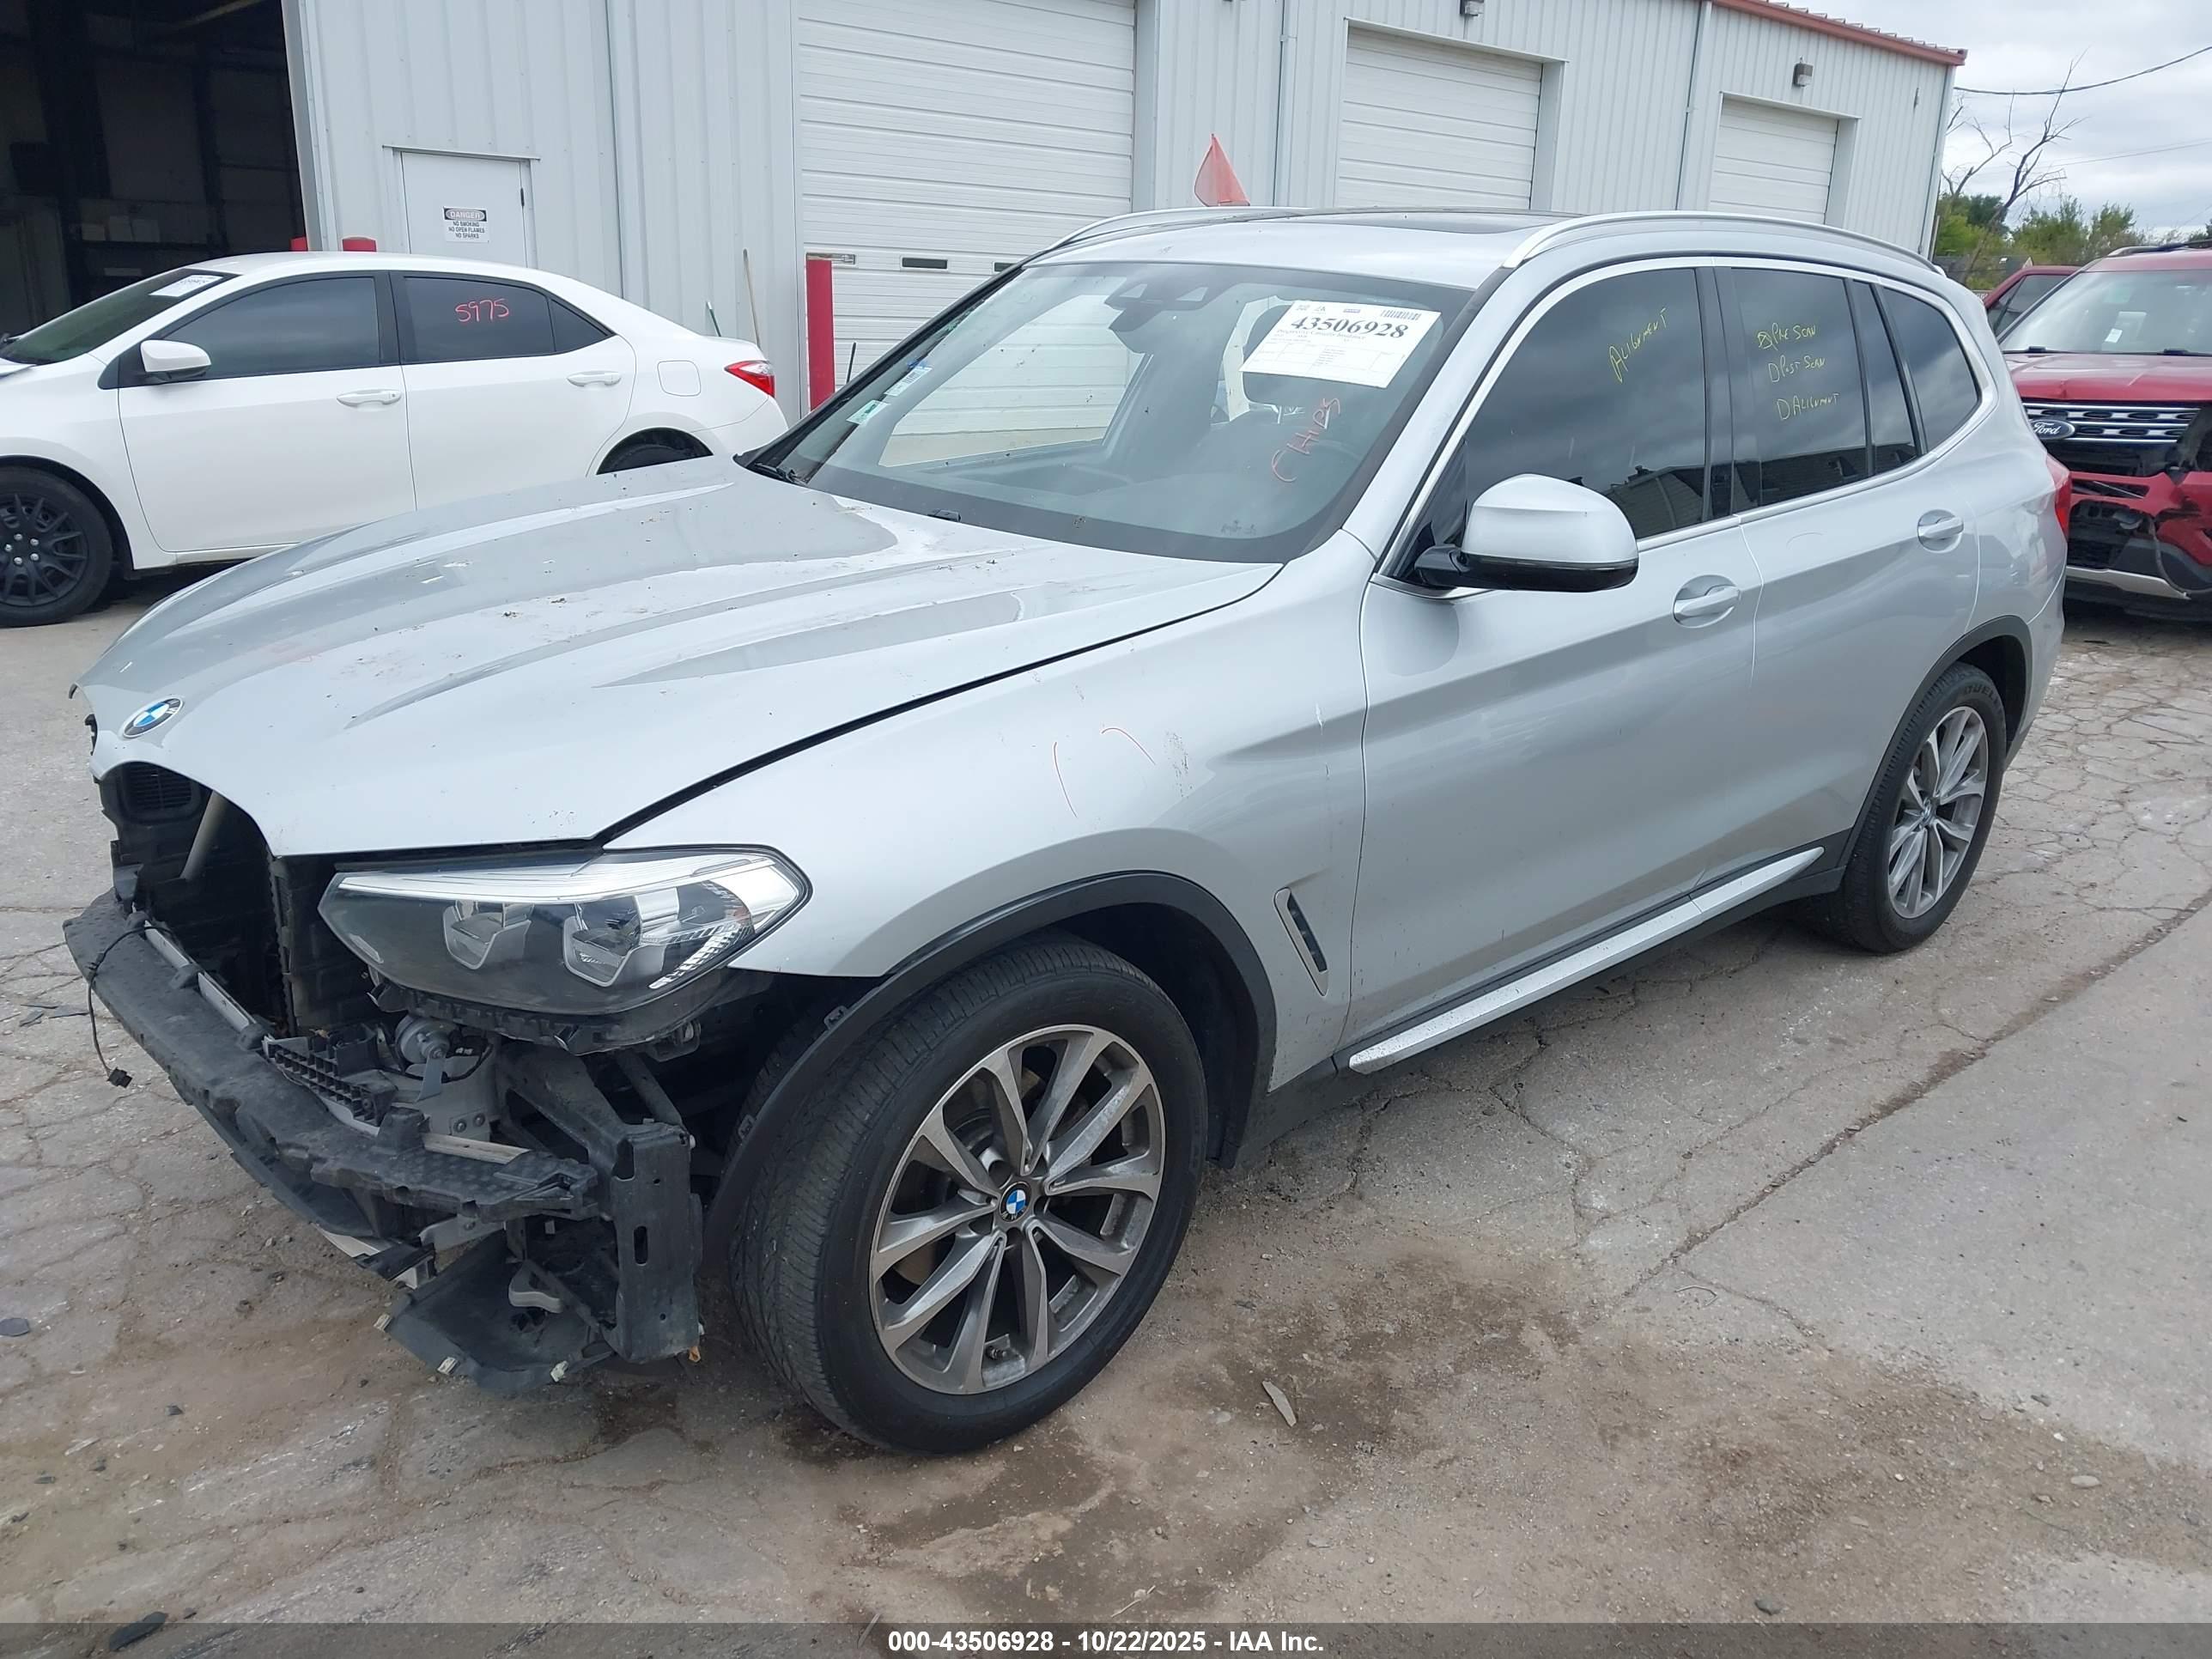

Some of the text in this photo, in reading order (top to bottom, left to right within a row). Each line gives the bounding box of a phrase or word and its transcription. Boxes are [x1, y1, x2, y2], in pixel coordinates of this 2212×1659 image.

[454, 298, 509, 323] 5975
[1291, 316, 1408, 338] 43506928
[2033, 422, 2062, 435] Ford
